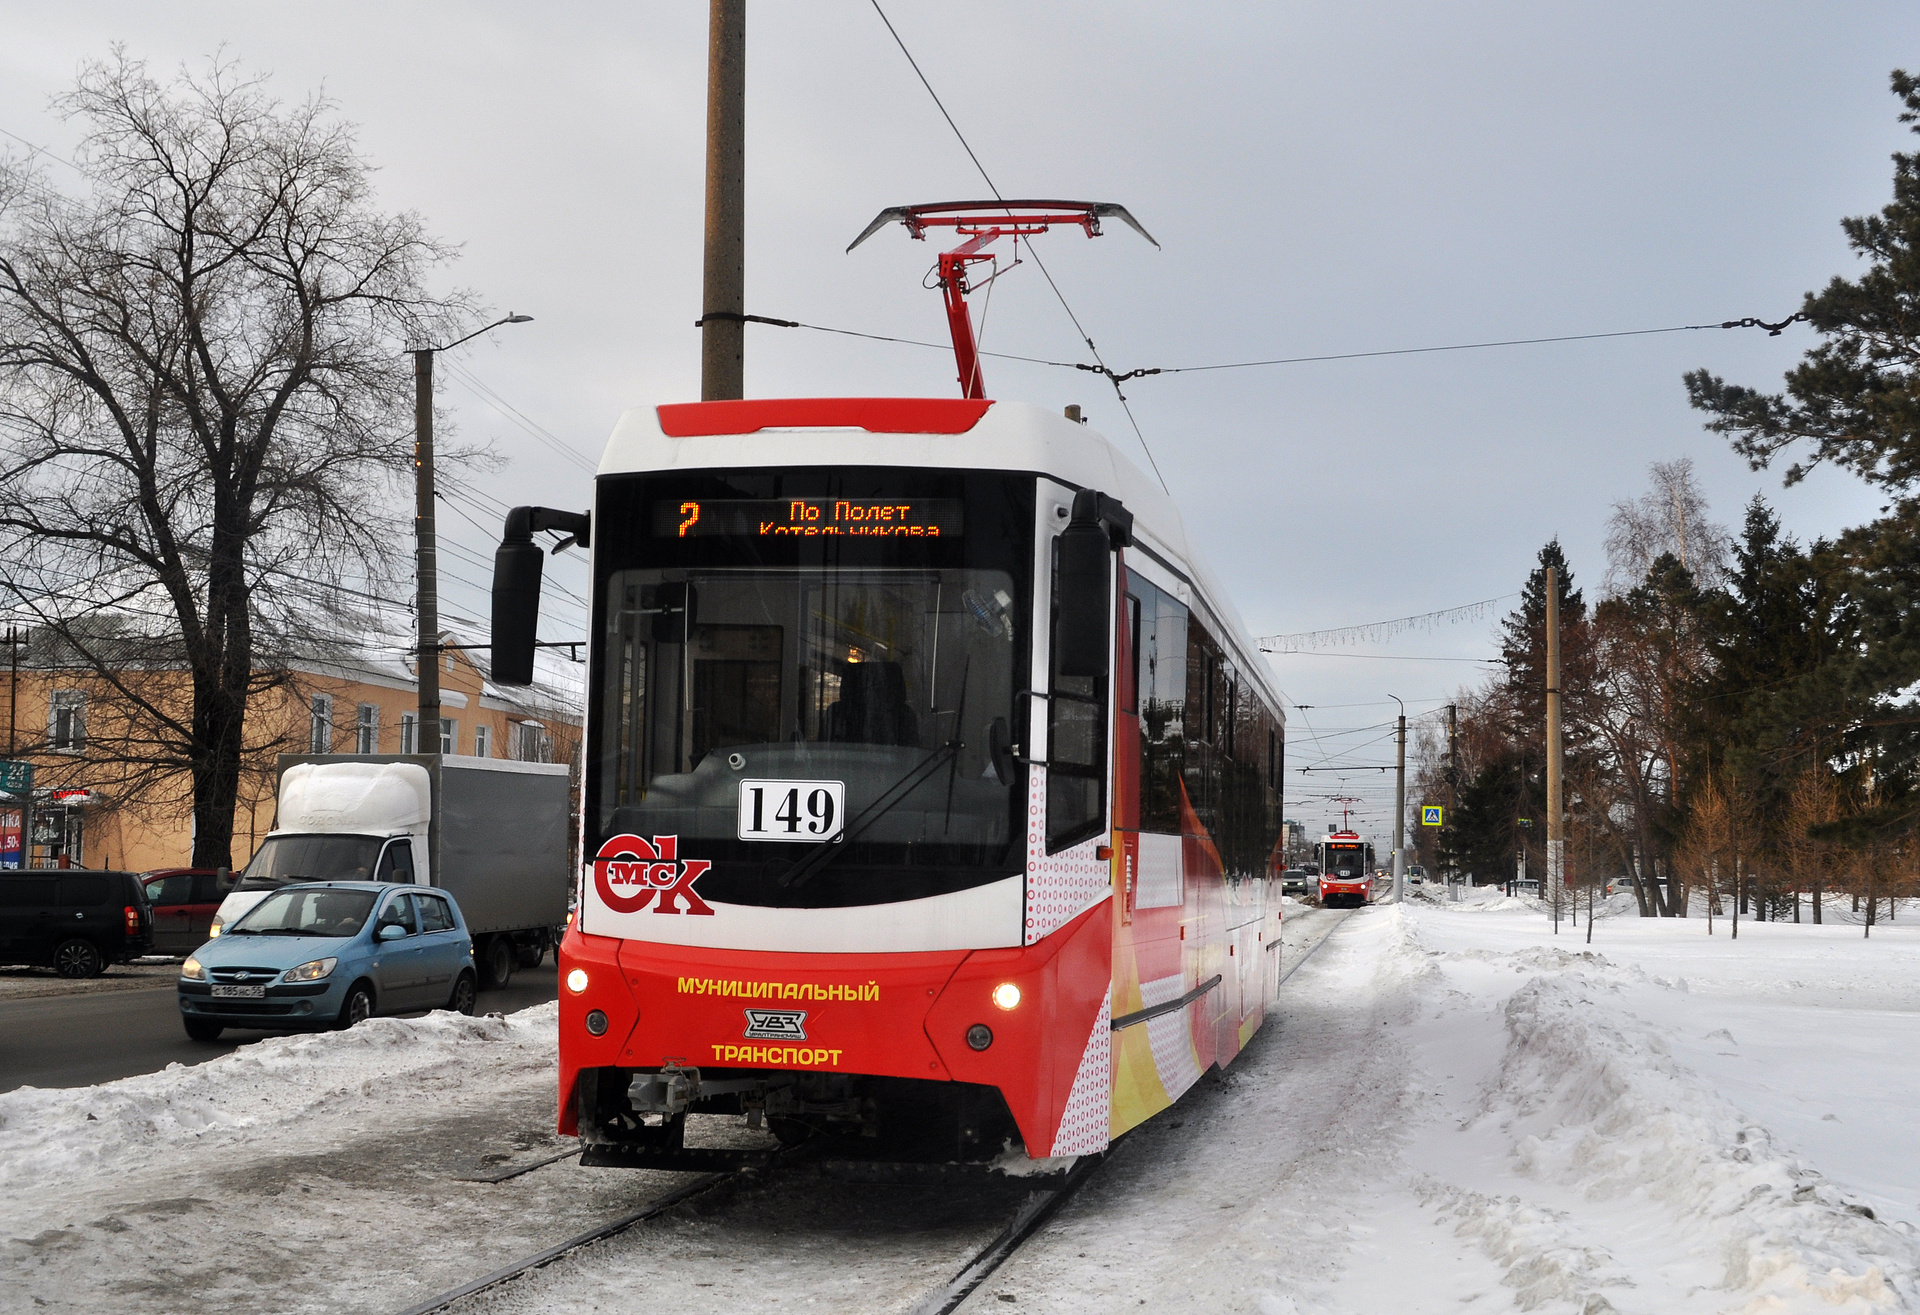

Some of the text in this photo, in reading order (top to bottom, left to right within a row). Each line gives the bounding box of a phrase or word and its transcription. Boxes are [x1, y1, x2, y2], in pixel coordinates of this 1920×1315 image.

[790, 501, 820, 521] По
[835, 501, 910, 521] Полет
[746, 787, 835, 835] 149
[677, 976, 880, 1001] МУНИЦИПАЛЬНЫЙ
[711, 1044, 843, 1066] ТРАНСПОРТ
